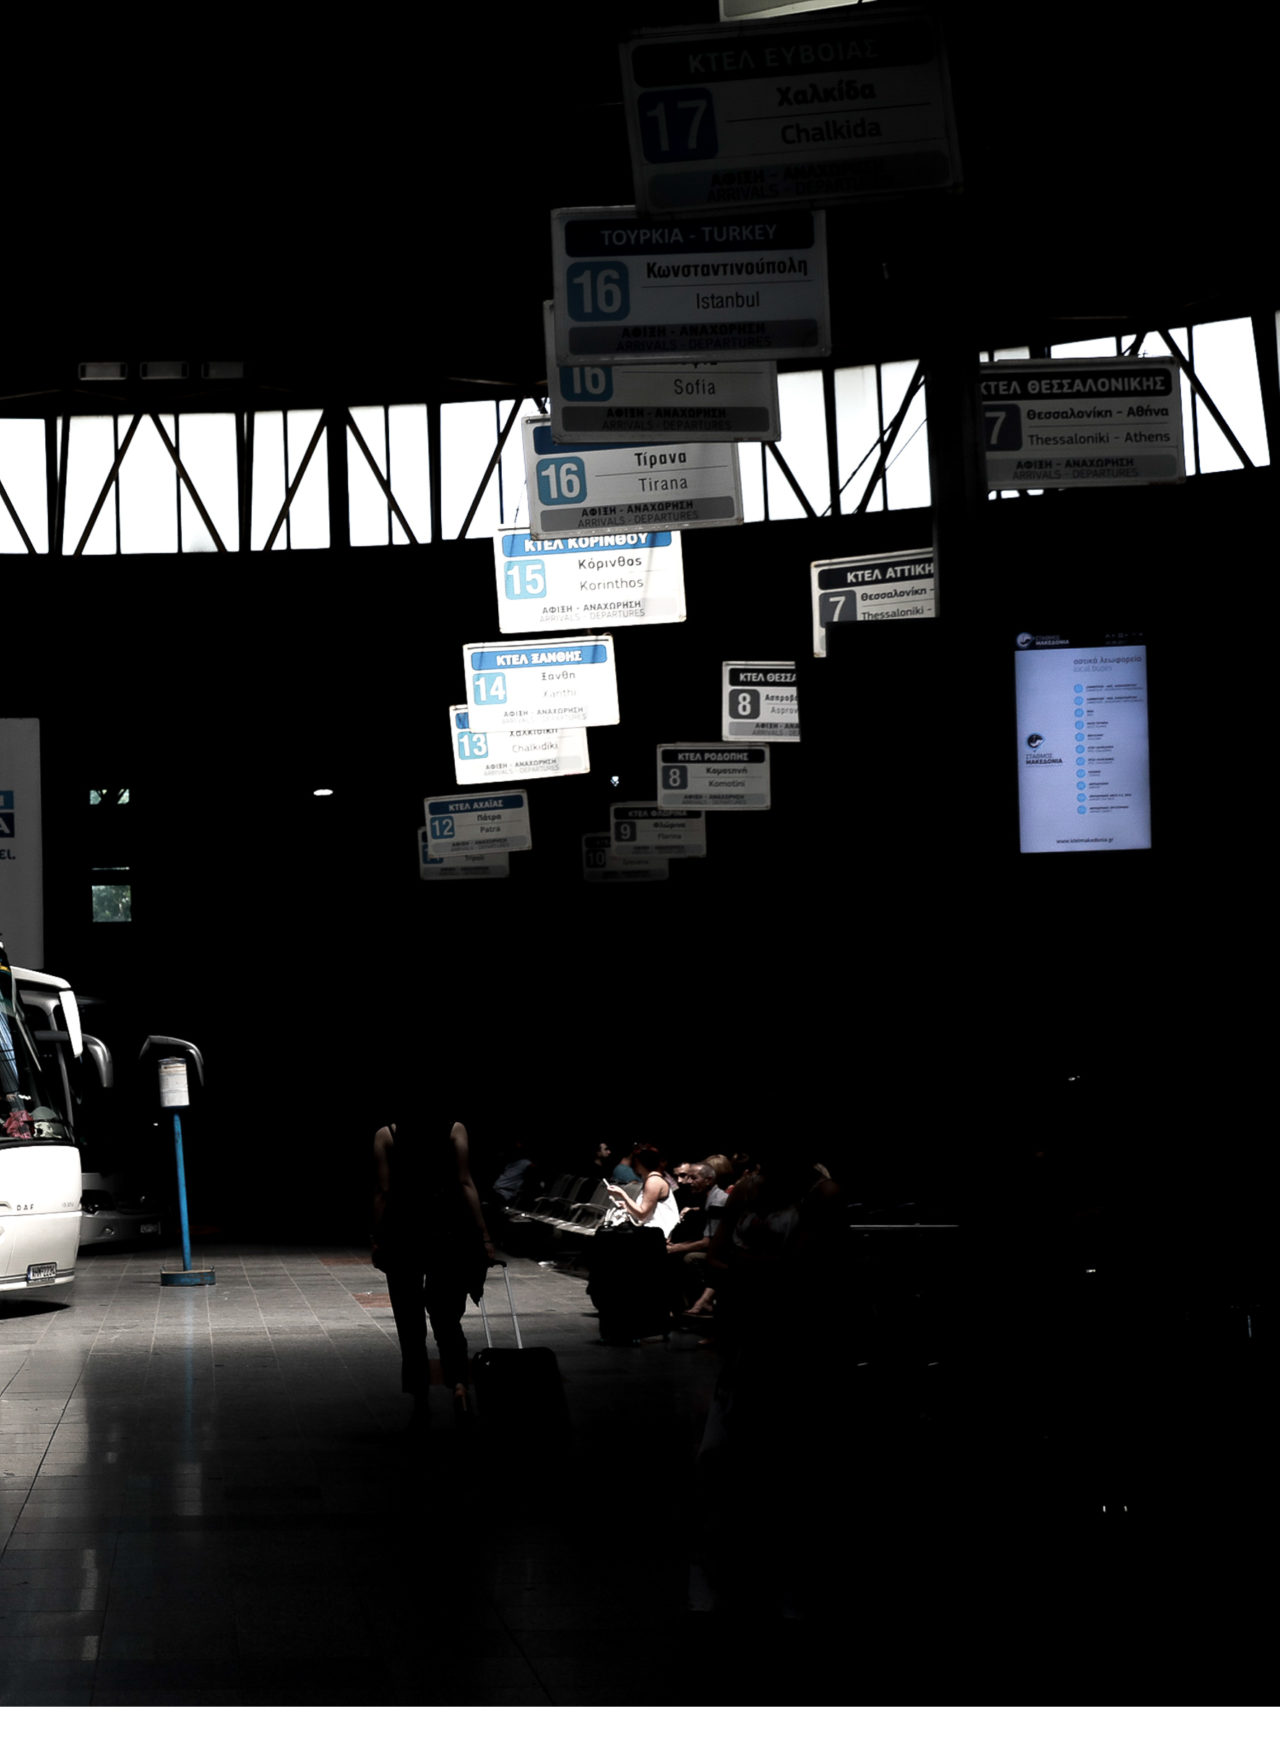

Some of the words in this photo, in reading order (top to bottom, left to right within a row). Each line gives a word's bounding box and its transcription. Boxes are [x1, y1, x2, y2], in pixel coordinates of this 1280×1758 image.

[688, 49, 756, 75] ΚΤΕΛ
[777, 79, 877, 107] Χαλκίδα
[645, 98, 709, 153] 17
[781, 117, 882, 145] Chalkida
[600, 226, 685, 246] ΤΟΥΡΚΙΑ
[700, 223, 778, 243] TURKEY
[646, 256, 809, 279] Κωνσταντινούπολη
[572, 269, 623, 315] 16
[696, 291, 761, 310] Istanbul
[673, 378, 716, 397] Sofia
[1027, 376, 1166, 395] ΘΕΣΣΑΛΟΝΙΚΗΣ
[1026, 406, 1113, 420] Θεσσαλονίκη
[1126, 405, 1169, 417] Αθήνα
[984, 411, 1007, 445] 7
[1028, 432, 1110, 446] Thessaloniki
[1124, 430, 1170, 443] Athens
[634, 450, 687, 469] Τίρανα
[540, 462, 581, 499] 16
[638, 475, 688, 492] Tirana
[567, 532, 649, 550] ΚΟΡΙΝΘΟΥ
[578, 555, 643, 572] Κόρινθος
[507, 564, 545, 596] 15
[580, 577, 644, 592] Korinthos
[846, 568, 883, 584] ΚΤΕΛ
[496, 655, 529, 666] ΚΤΕΛ
[531, 650, 584, 664] ΞΑΝΘΗΣ
[739, 672, 765, 682] ΚΤΕΛ
[475, 676, 506, 702] 14
[738, 693, 751, 716] 8
[459, 734, 487, 757] 13
[677, 752, 703, 761] ΚΤΕΛ
[668, 768, 681, 787] 8
[432, 818, 454, 837] 12
[620, 823, 632, 840] 9
[587, 850, 605, 866] 10
